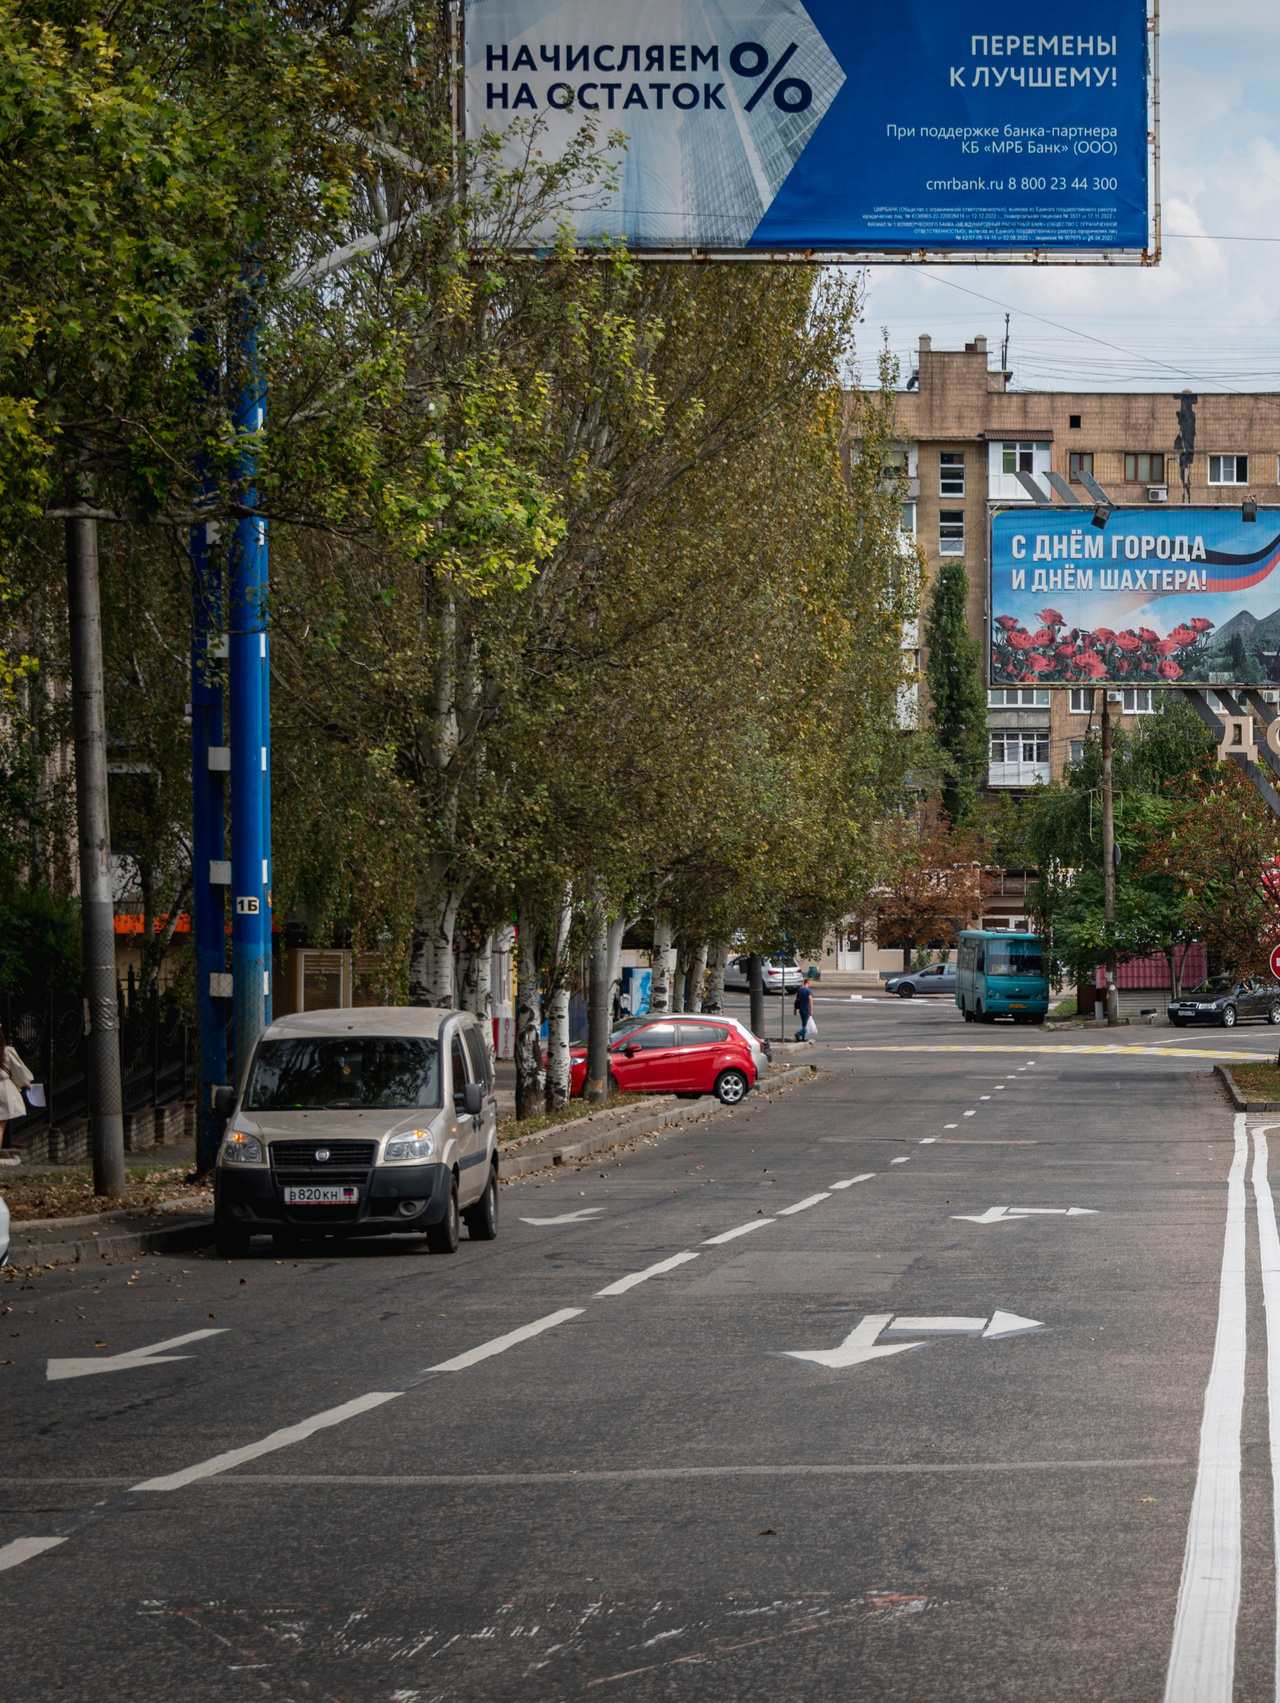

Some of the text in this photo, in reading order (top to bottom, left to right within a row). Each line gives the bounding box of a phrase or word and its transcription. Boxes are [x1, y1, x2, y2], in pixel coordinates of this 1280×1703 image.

[971, 35, 1117, 56] ПЕРЕМЕНЫ
[486, 44, 719, 72] НАЧИСЛЯЕМ
[950, 66, 1118, 87] К ЛУЧШЕМУ!
[486, 82, 727, 110] НА ОСТАТОК
[886, 124, 1118, 140] При поддержке банка-партнера
[961, 141, 1118, 156] КБ «МРБ Банк» (ООО)
[926, 177, 1118, 190] cmrbank.ru 8 800 23 44 300
[1012, 529, 1207, 563] С ДНЁМ ГОРОДА
[1012, 564, 1207, 593] И ДНЁМ ШАХТЕРА!
[237, 899, 258, 912] 1Б
[289, 1188, 338, 1201] В820КН
